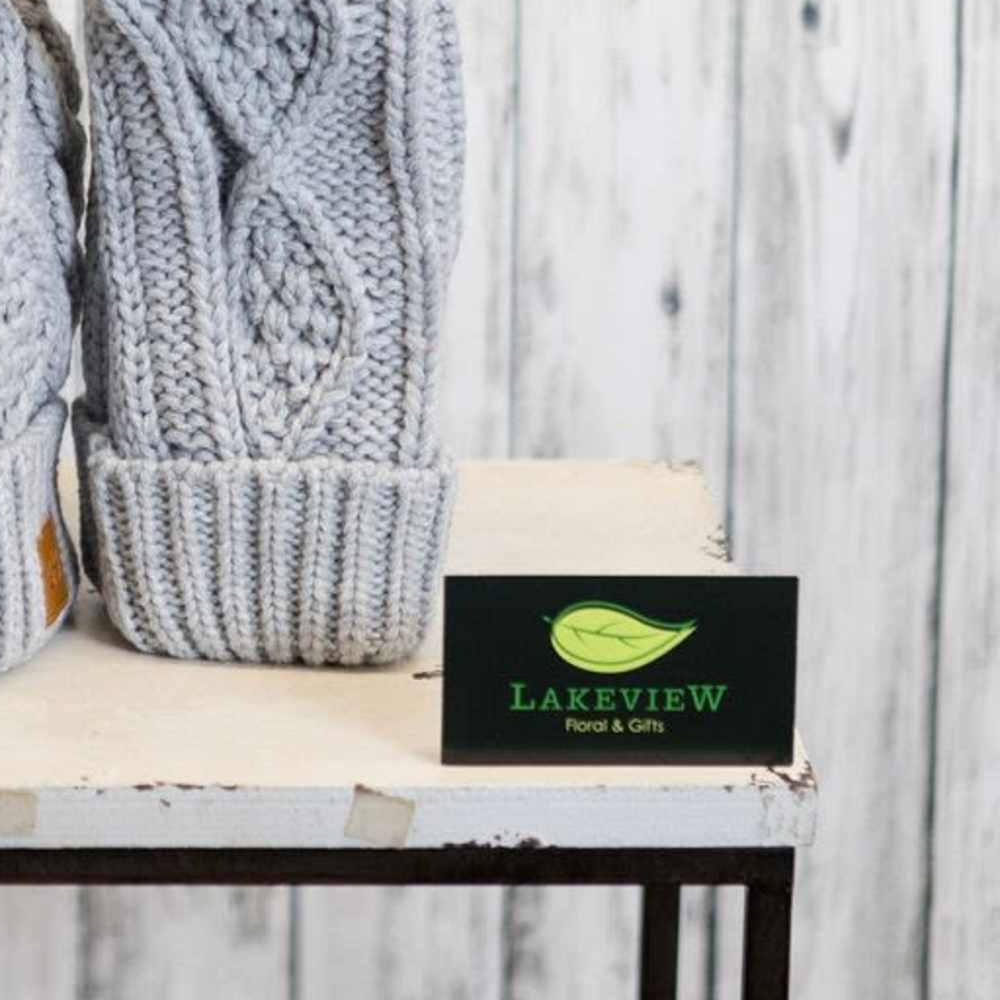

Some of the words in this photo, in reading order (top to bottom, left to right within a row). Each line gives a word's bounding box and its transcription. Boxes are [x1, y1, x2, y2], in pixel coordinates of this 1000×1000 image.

[509, 682, 728, 713] LAKEVIEW
[565, 717, 608, 734] Floral
[611, 718, 624, 734] &
[628, 717, 665, 734] Gifts
